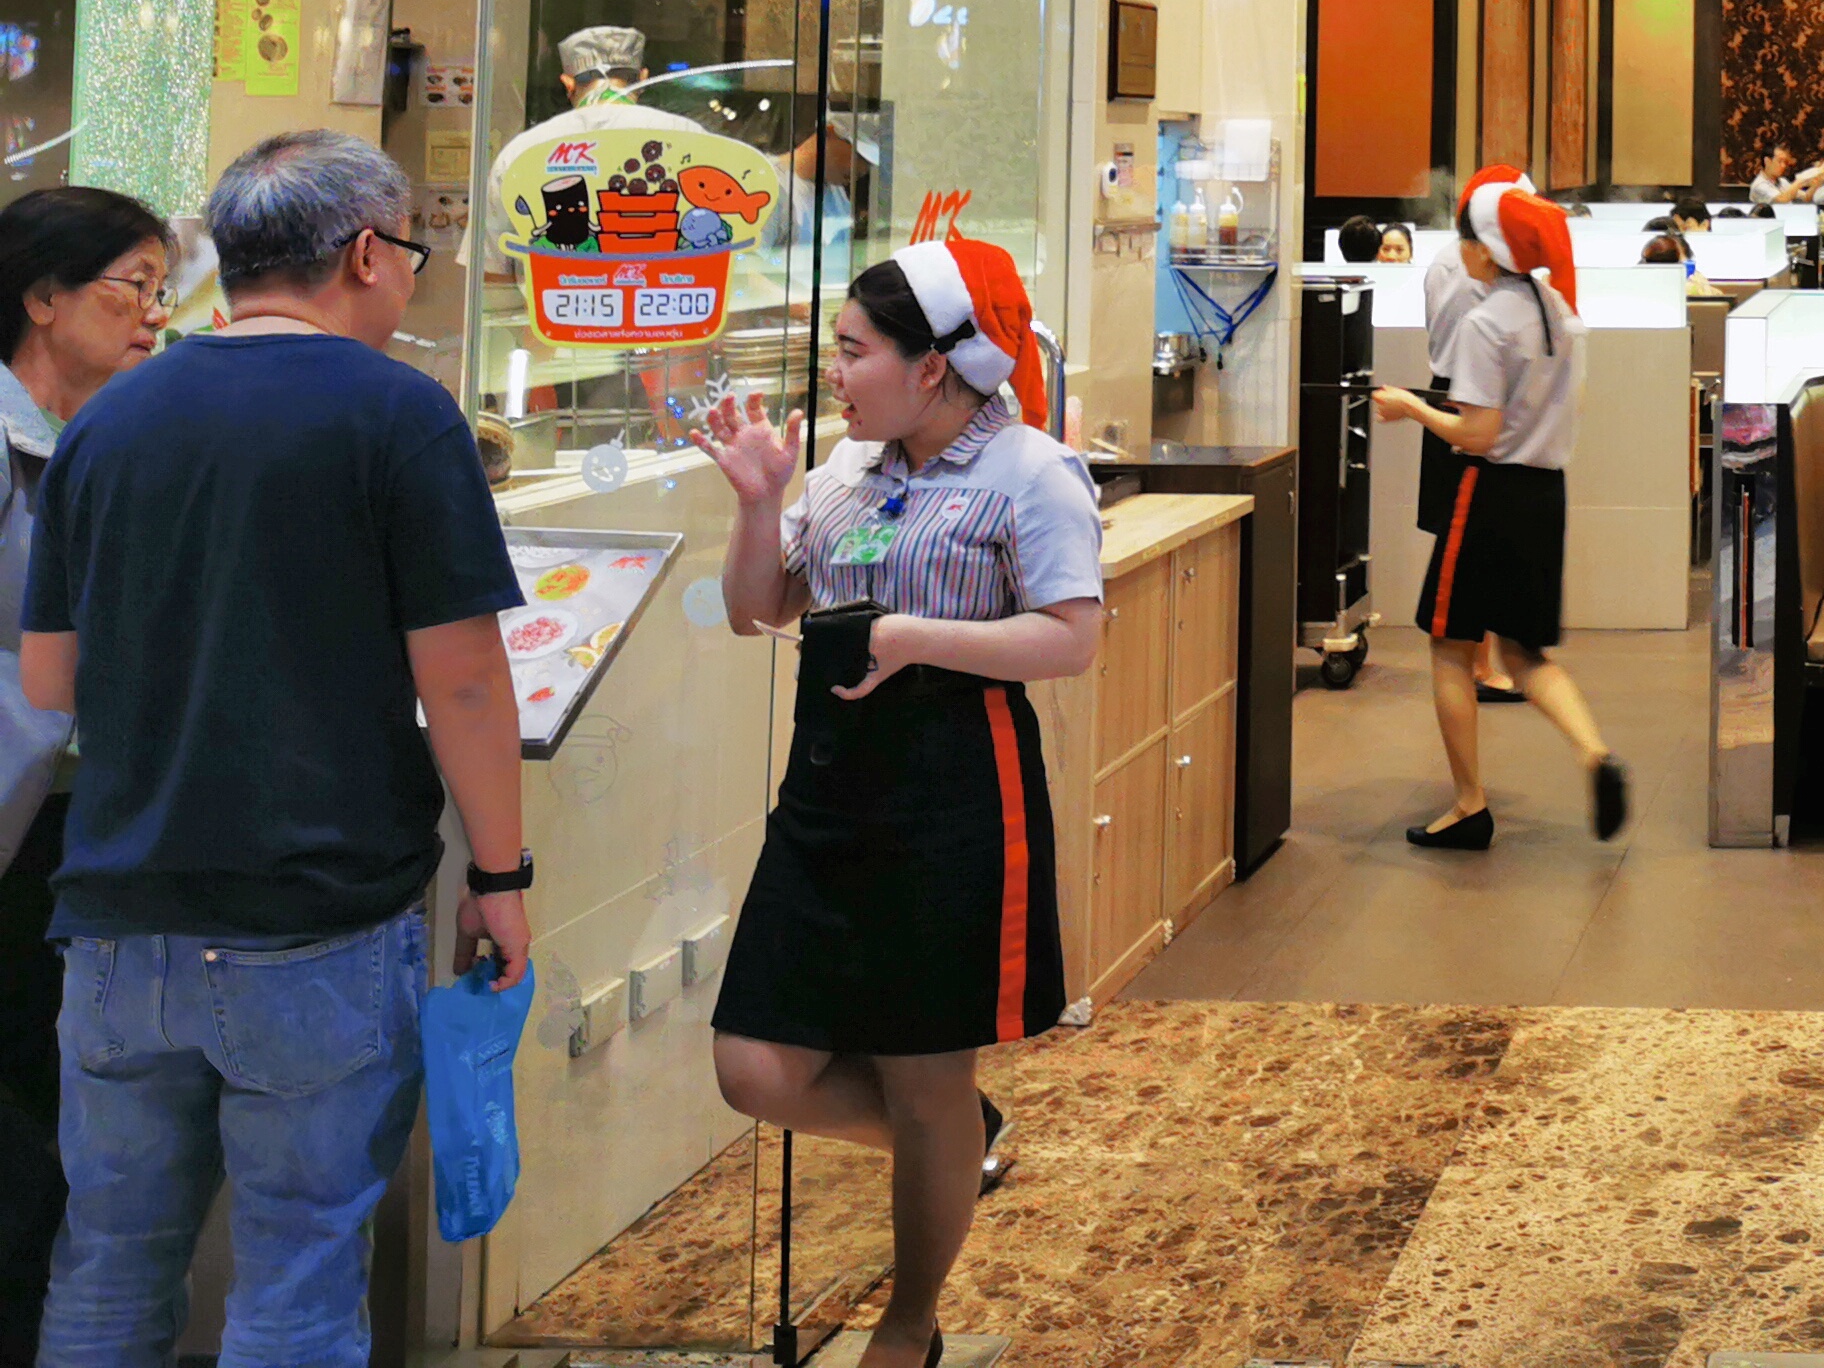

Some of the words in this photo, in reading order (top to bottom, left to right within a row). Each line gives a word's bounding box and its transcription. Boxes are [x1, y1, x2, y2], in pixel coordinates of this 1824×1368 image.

[547, 142, 597, 164] MK
[555, 293, 614, 318] 21:15
[639, 292, 709, 317] 22:00
